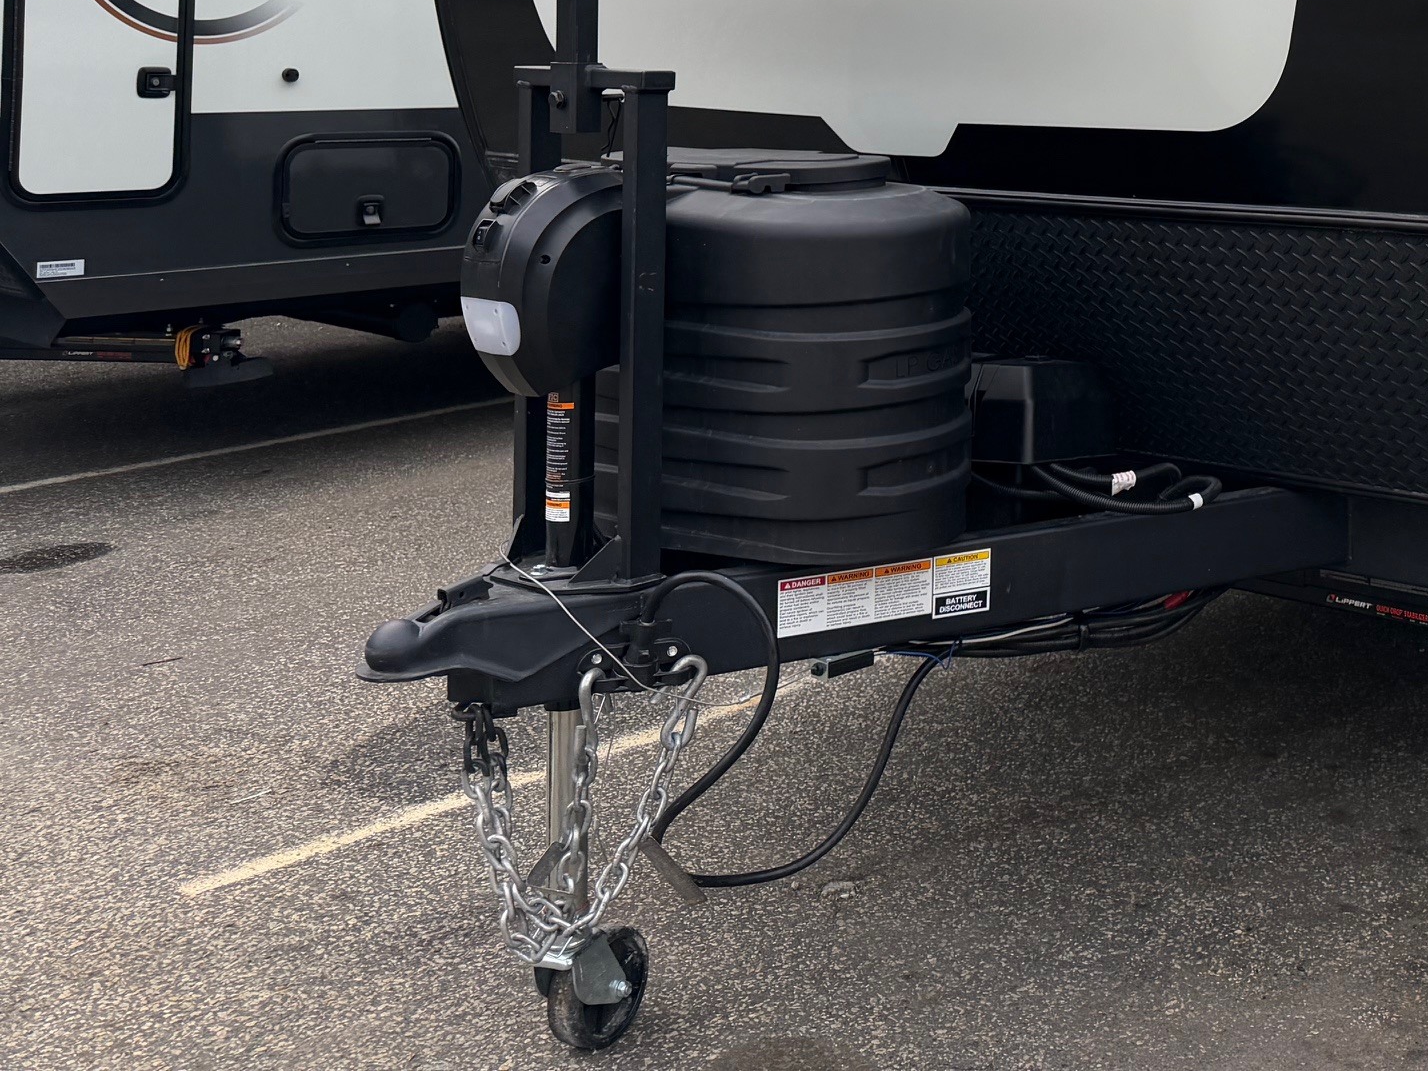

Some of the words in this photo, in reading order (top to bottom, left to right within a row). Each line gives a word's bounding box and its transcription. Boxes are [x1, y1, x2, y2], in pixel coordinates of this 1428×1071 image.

[952, 553, 979, 563] CAUTION
[890, 562, 922, 574] WARNING
[837, 570, 870, 582] WARNING
[791, 577, 822, 588] DANGER
[945, 593, 977, 605] BATTERY
[939, 600, 983, 613] DISCONNECT
